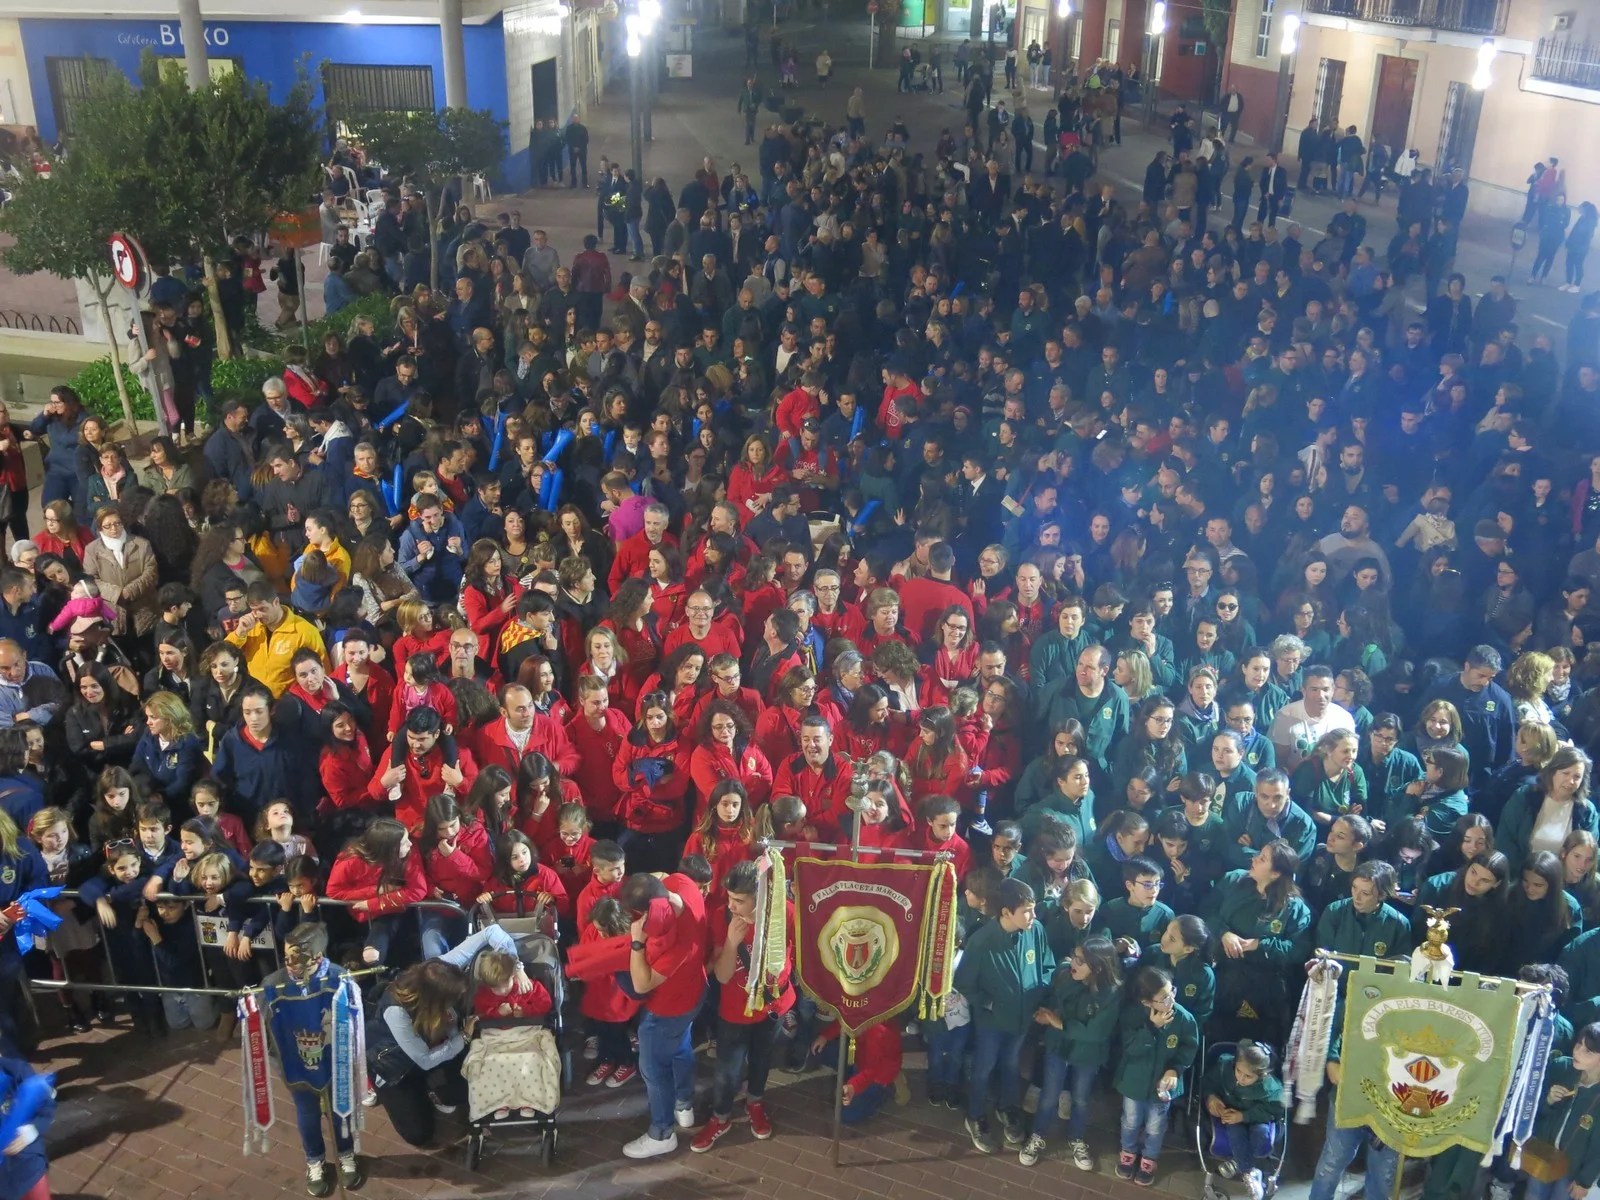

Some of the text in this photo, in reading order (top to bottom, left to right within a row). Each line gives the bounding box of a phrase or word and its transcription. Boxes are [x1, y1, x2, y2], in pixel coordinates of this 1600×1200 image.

[816, 884, 840, 900] FALLA
[1363, 1003, 1391, 1033] FALLA
[1396, 999, 1421, 1009] ELS
[1427, 1000, 1476, 1024] BARRIS
[1535, 1033, 1550, 1067] Fallera
